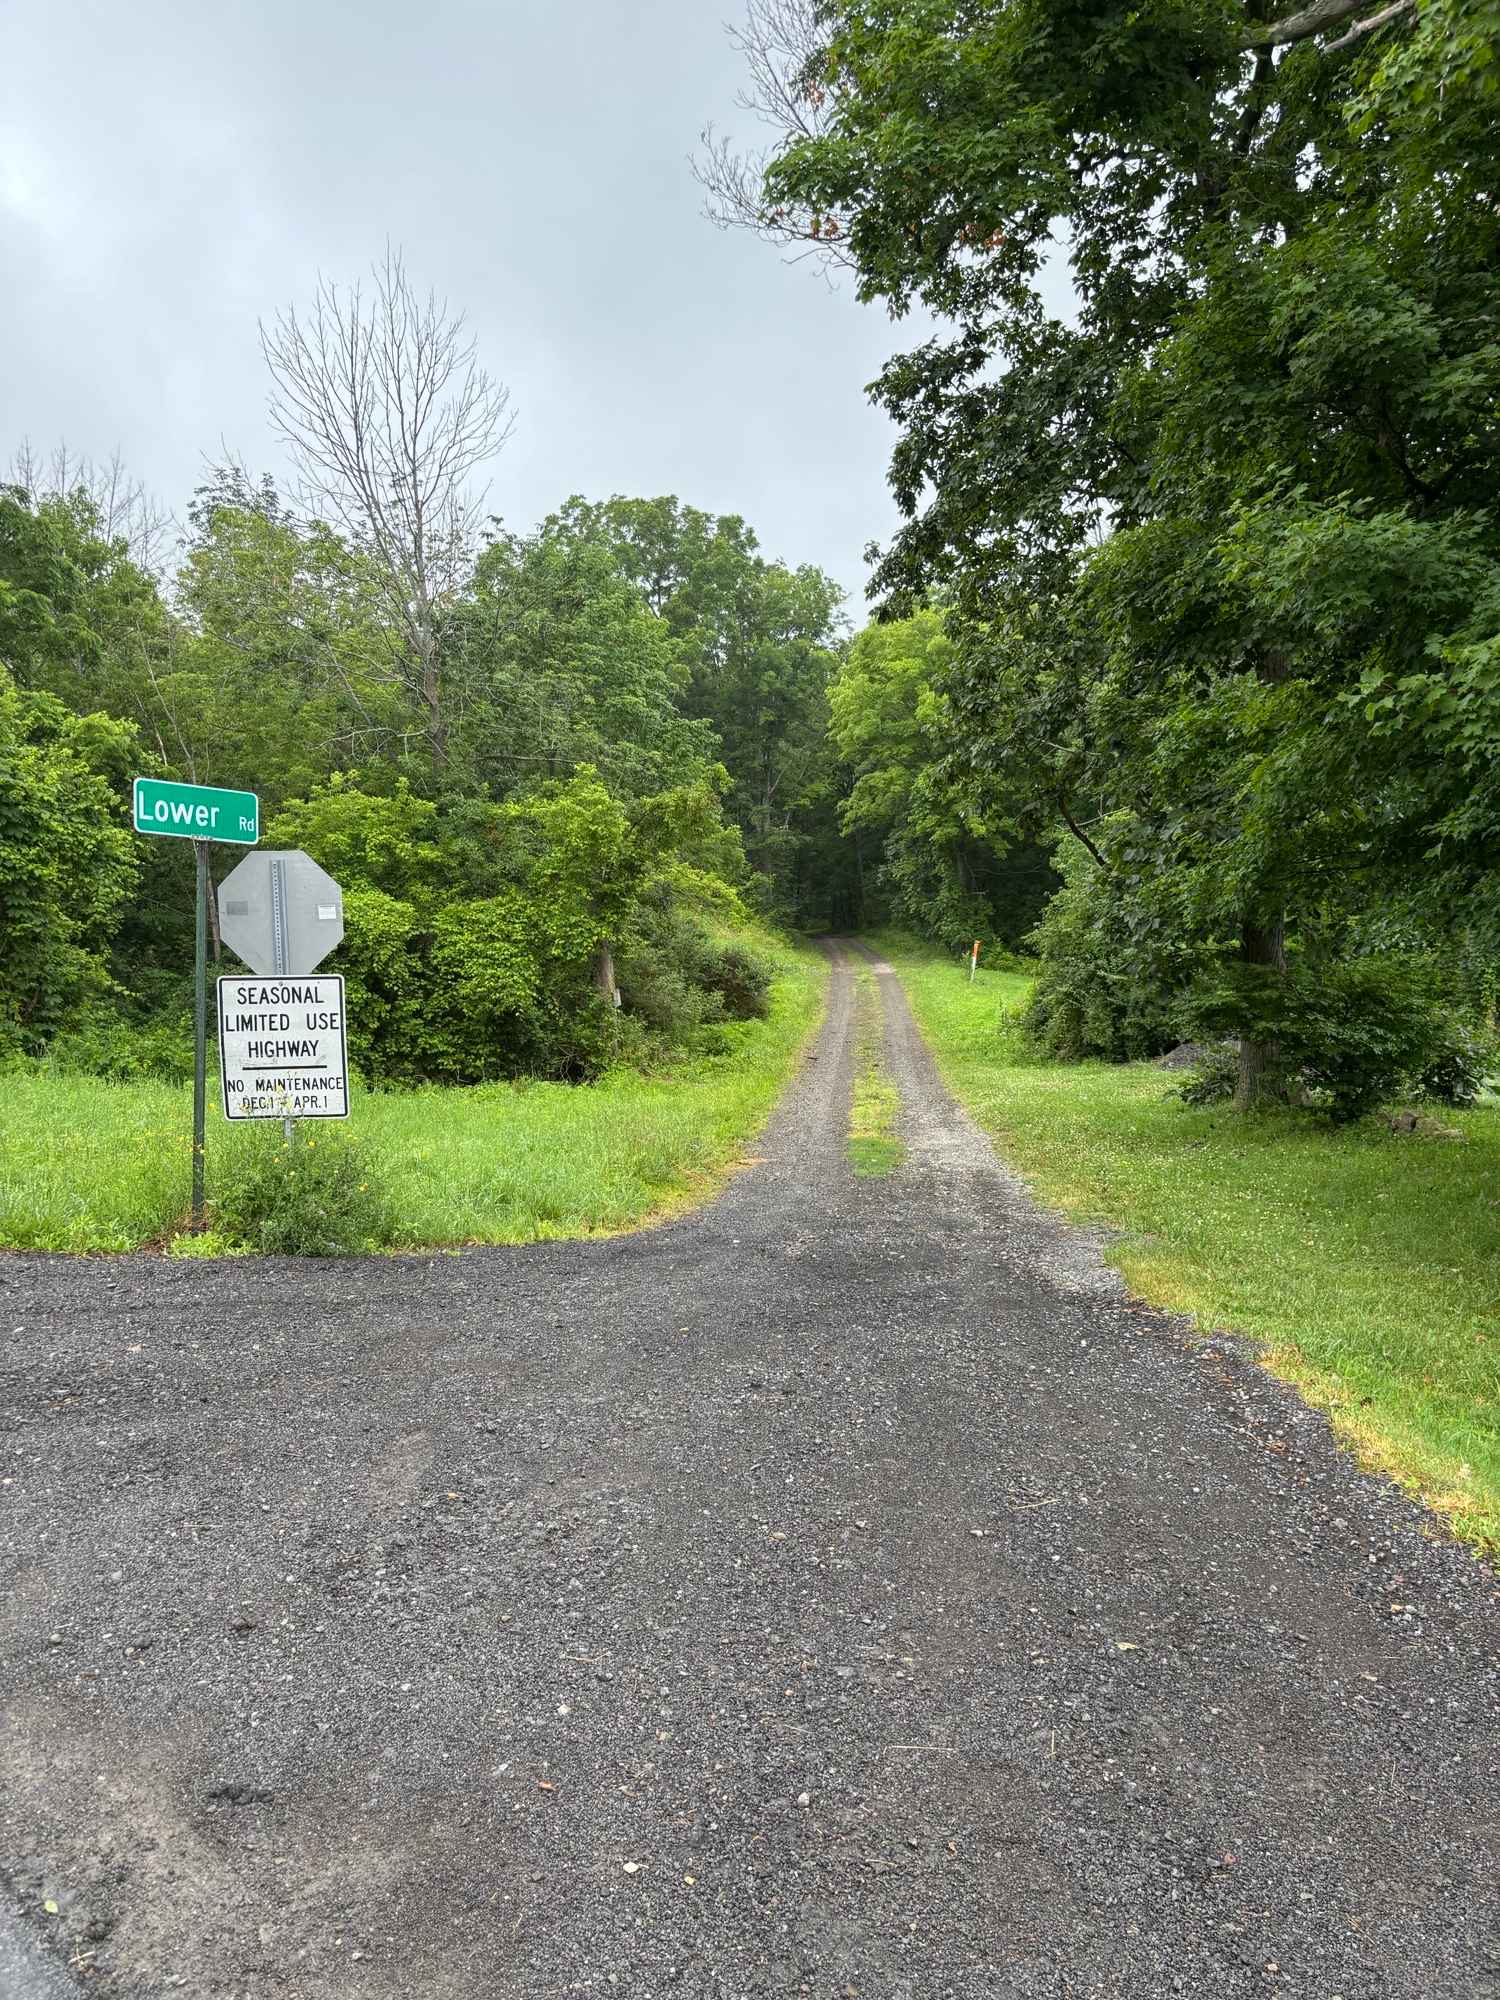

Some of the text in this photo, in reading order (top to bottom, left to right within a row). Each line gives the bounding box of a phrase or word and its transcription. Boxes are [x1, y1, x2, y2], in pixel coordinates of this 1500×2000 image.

[138, 790, 255, 832] Lower Rd
[237, 986, 325, 1005] SEASONAL
[225, 1012, 340, 1032] LIMITED USE
[248, 1040, 319, 1058] HIGHWAY
[227, 1076, 344, 1092] NO MAINTENANCE
